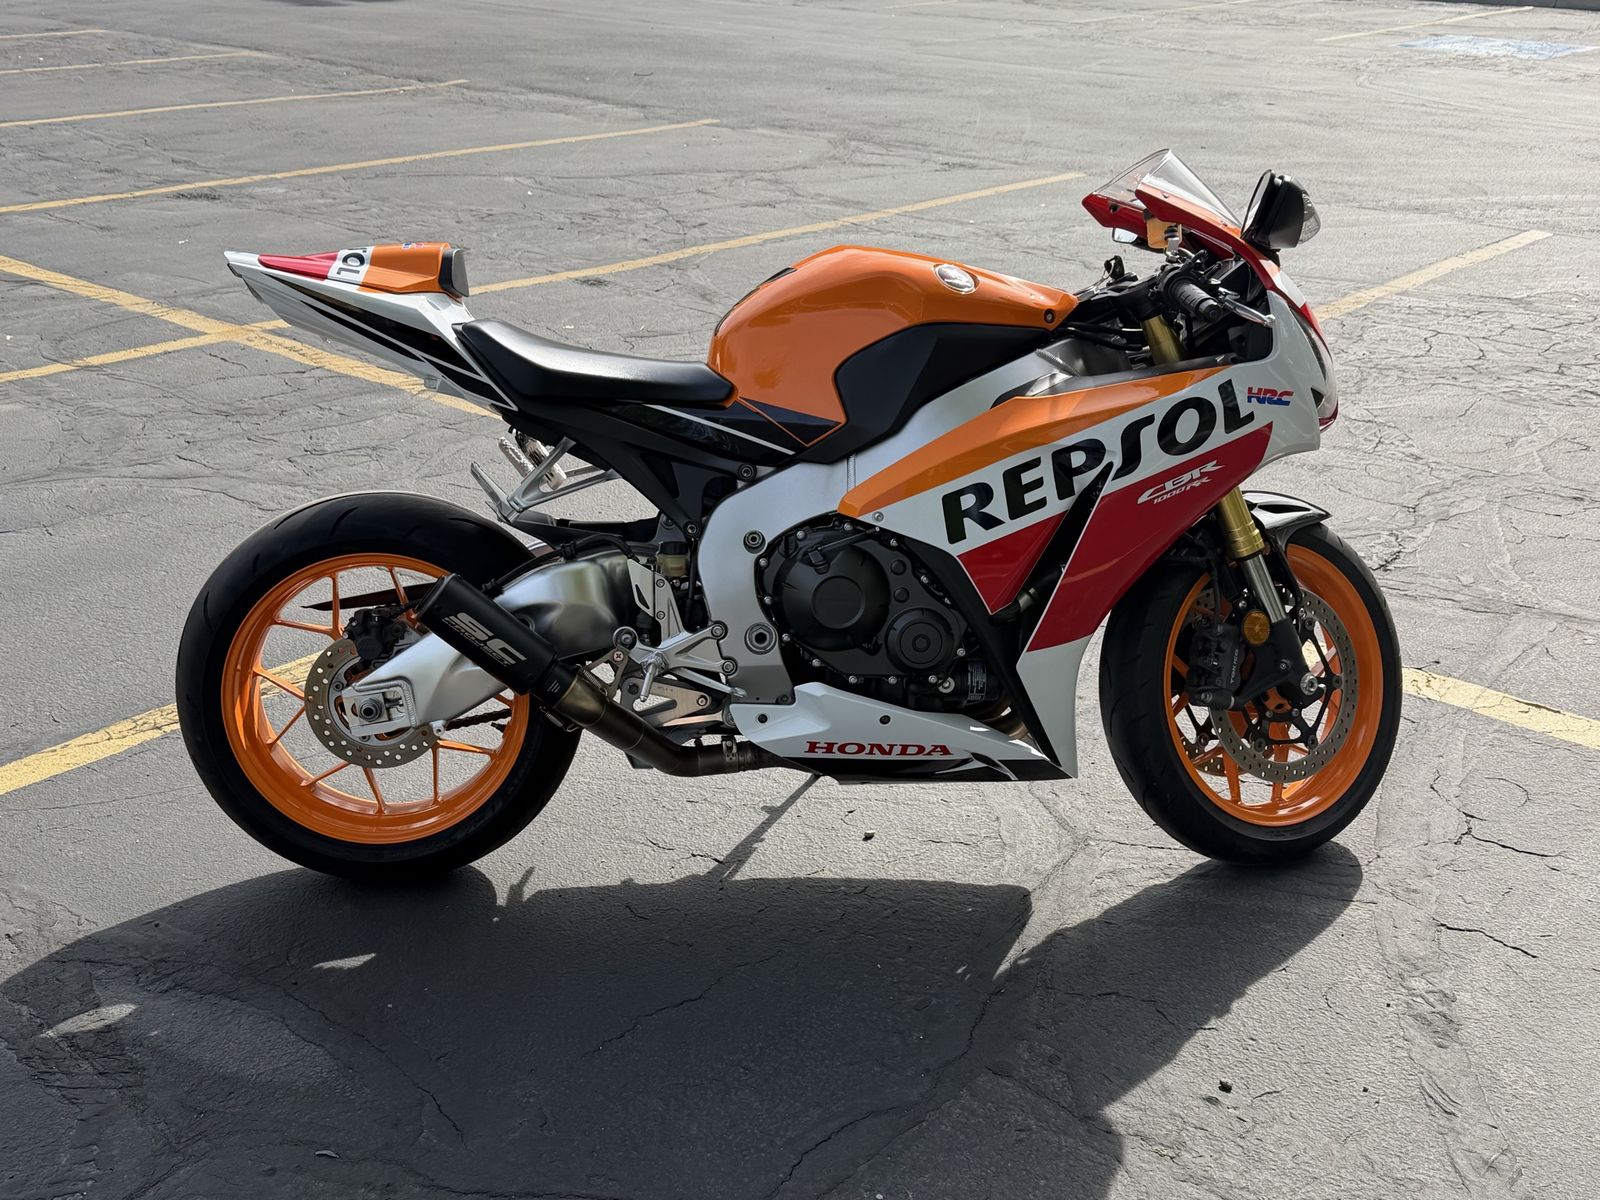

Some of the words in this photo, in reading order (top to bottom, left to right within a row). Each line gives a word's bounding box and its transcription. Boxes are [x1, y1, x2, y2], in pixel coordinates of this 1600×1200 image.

[1247, 386, 1294, 406] HRC
[941, 379, 1255, 545] REPSOL
[1137, 459, 1225, 504] CBR
[448, 612, 528, 664] SC
[804, 741, 954, 756] HONDA
